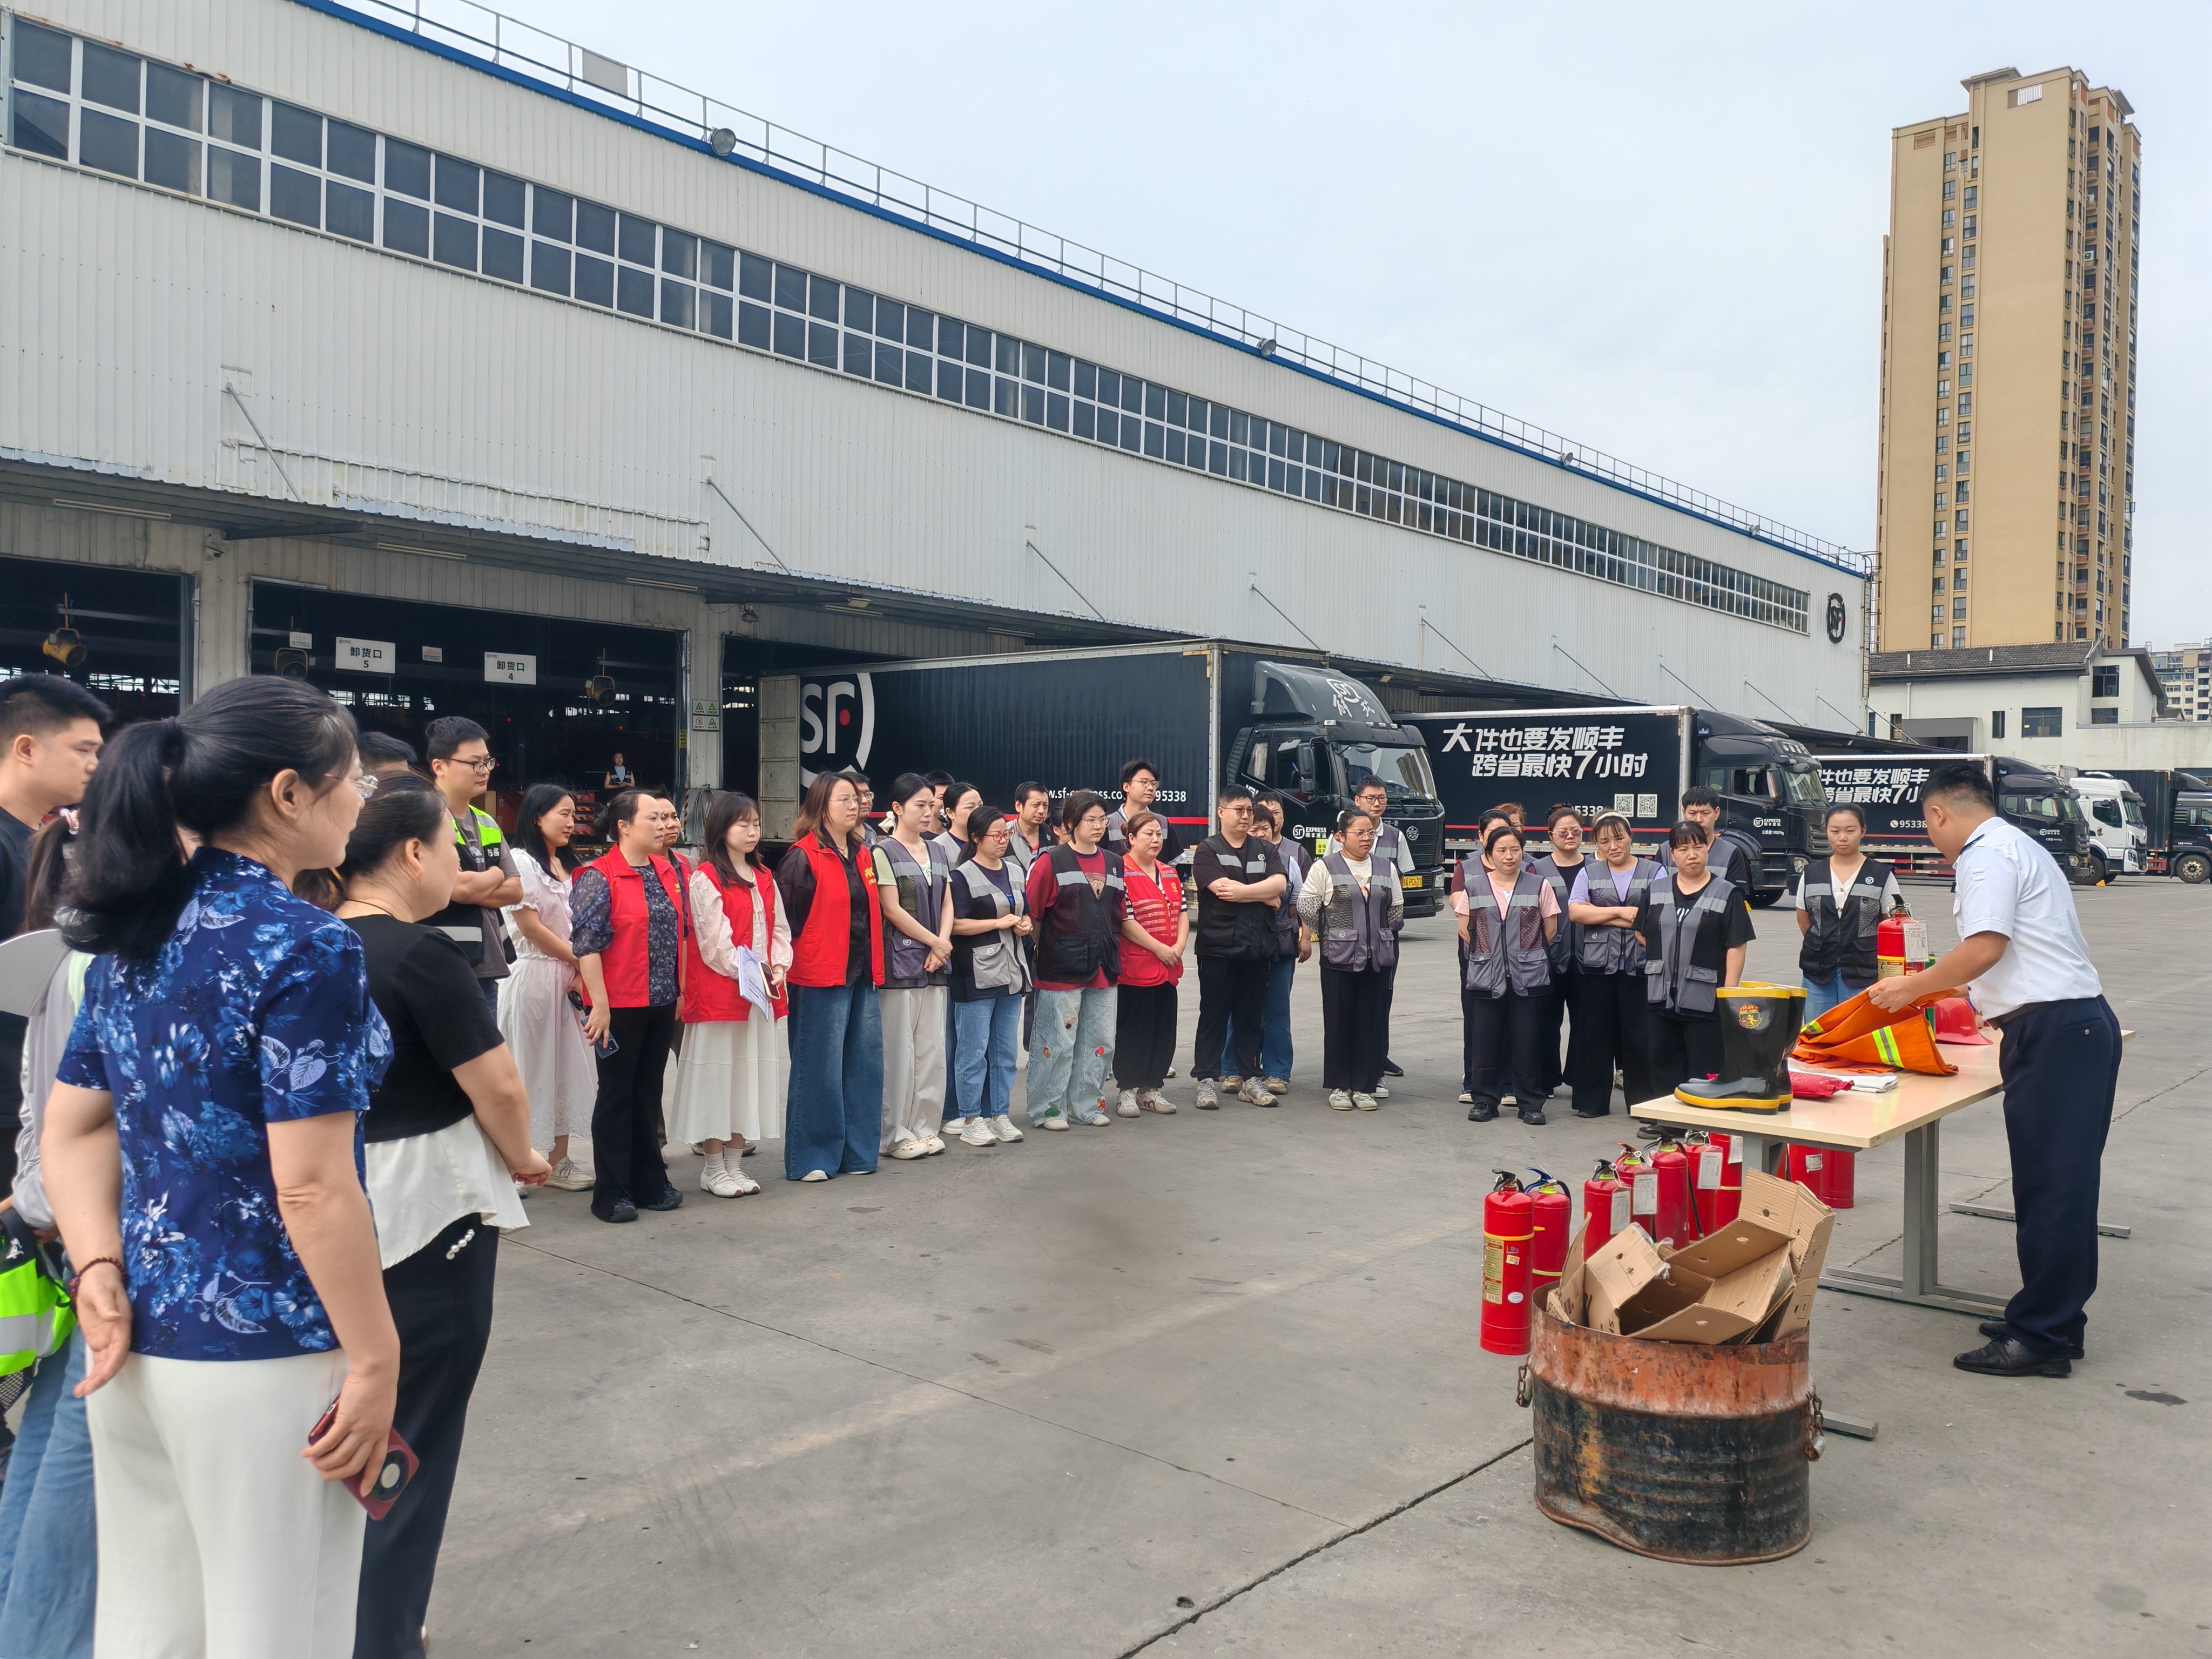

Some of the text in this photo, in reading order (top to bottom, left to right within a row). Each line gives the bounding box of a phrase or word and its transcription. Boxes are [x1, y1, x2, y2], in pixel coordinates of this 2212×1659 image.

[350, 646, 382, 659] 卸货口
[363, 660, 369, 668] 5
[497, 660, 524, 672] 卸货口
[1441, 723, 1625, 752] 大件也要发顺丰
[1472, 750, 1648, 779] 跨省最快7小时
[1155, 790, 1186, 802] 95338
[1572, 805, 1603, 817] 5338
[1899, 820, 1927, 828] 95338
